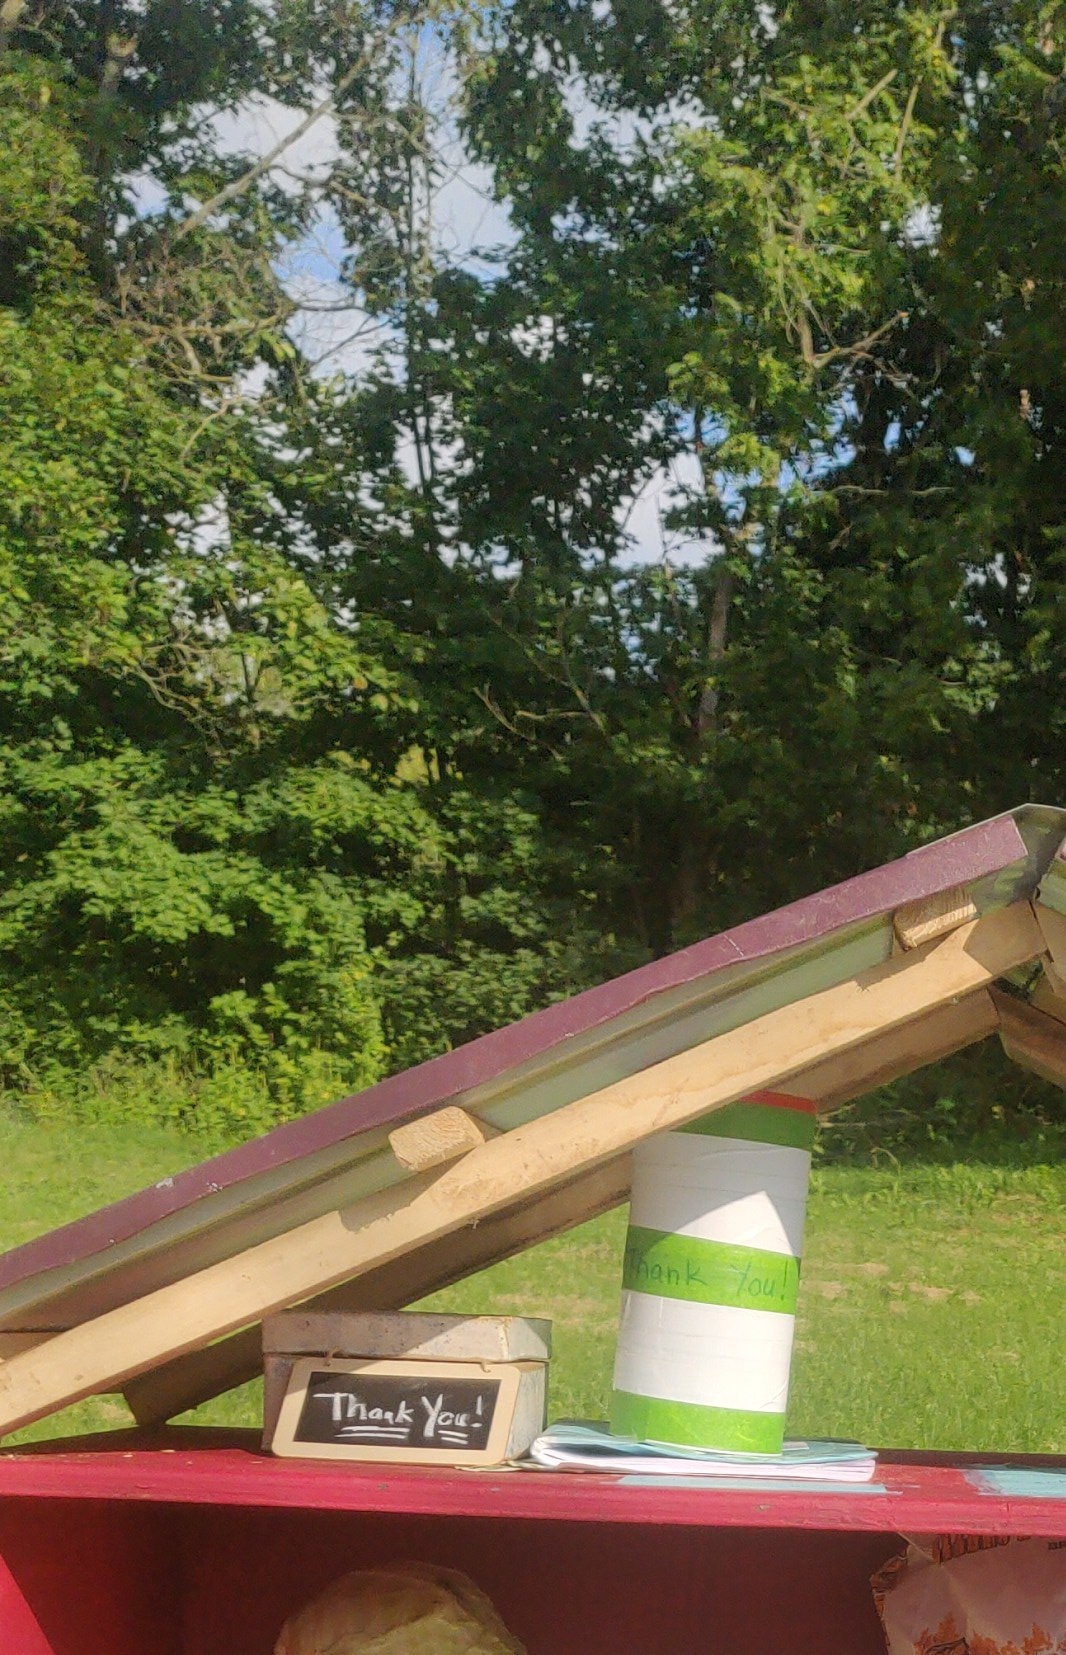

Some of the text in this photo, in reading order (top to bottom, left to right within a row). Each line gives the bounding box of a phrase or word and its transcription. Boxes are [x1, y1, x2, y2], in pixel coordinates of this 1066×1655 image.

[730, 1259, 790, 1301] You!
[312, 1392, 483, 1438] Thank You!
